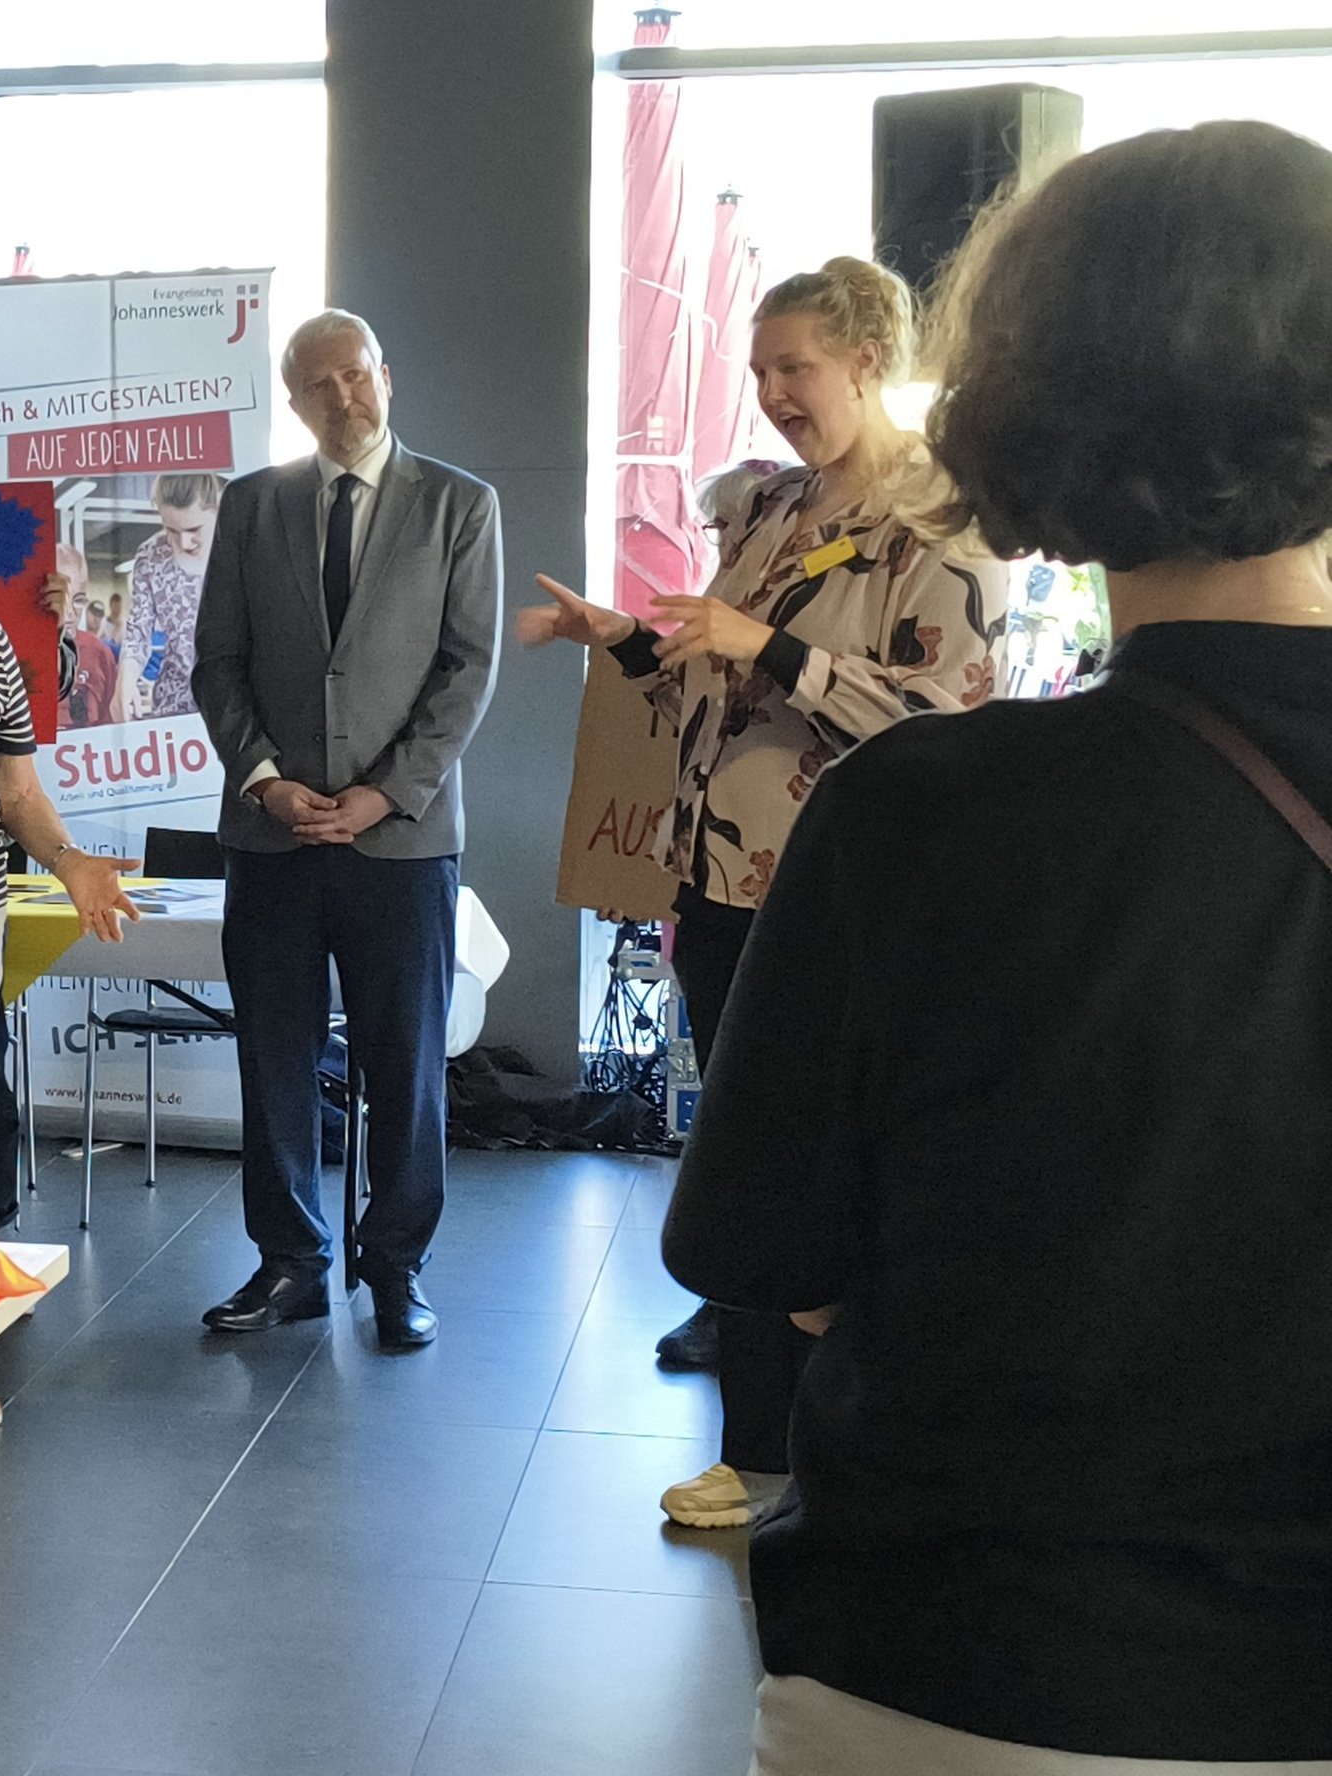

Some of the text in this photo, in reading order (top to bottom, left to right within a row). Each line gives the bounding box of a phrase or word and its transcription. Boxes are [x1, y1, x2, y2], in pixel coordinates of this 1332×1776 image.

[113, 303, 224, 321] Johanneswerk
[23, 401, 38, 420] &
[47, 376, 233, 419] MITGESTALTEN?
[26, 425, 204, 472] AUF JEDEN FALL!
[54, 730, 208, 788] Studjo
[51, 1022, 116, 1055] ICH
